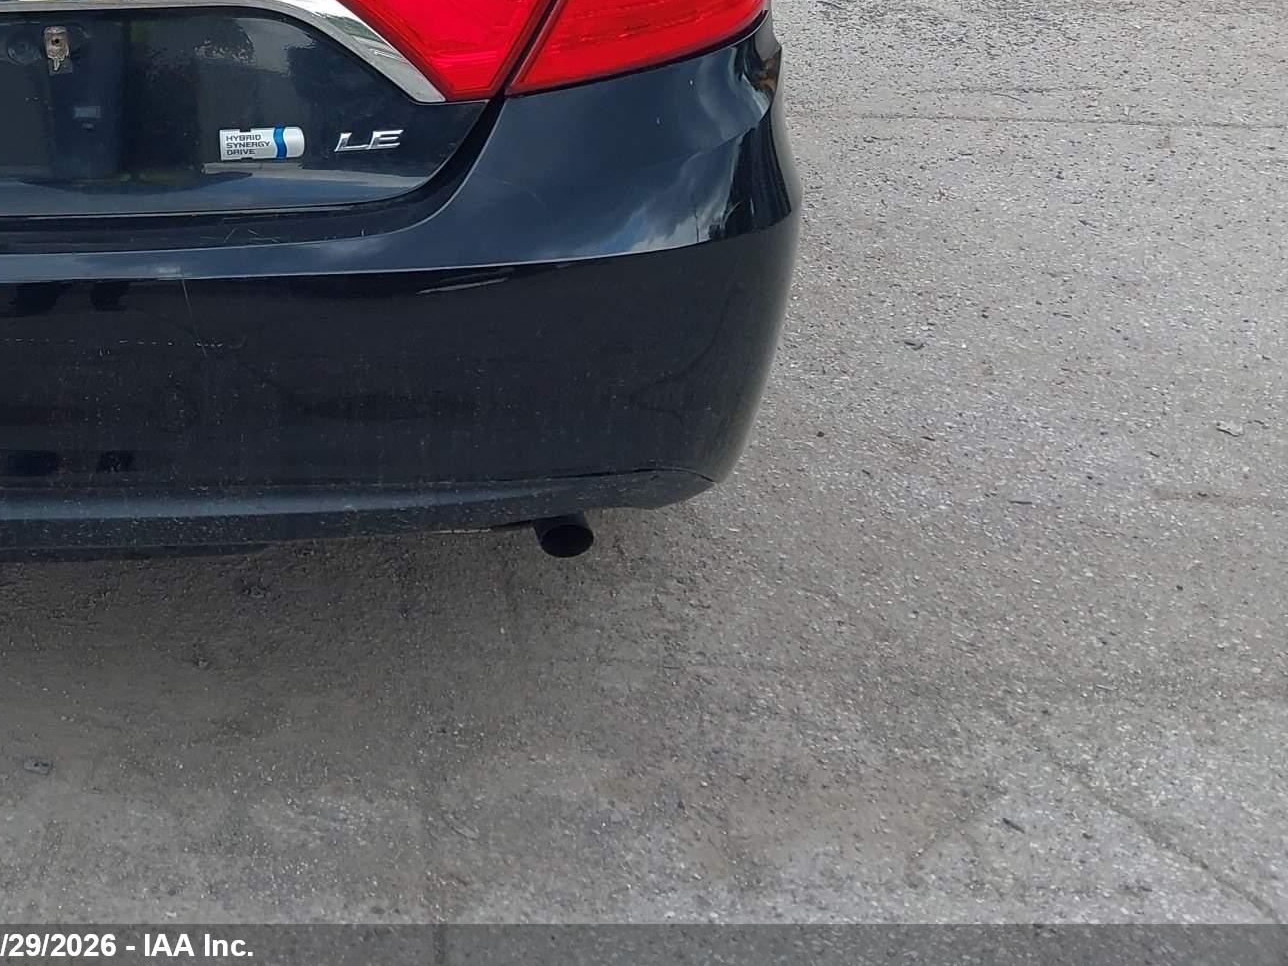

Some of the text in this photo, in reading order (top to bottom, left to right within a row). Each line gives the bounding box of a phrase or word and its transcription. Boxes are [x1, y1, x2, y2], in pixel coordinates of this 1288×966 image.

[225, 134, 262, 142] HYBRID
[334, 129, 404, 152] LE
[226, 141, 271, 149] SYNERGY
[226, 148, 256, 156] DRIVE
